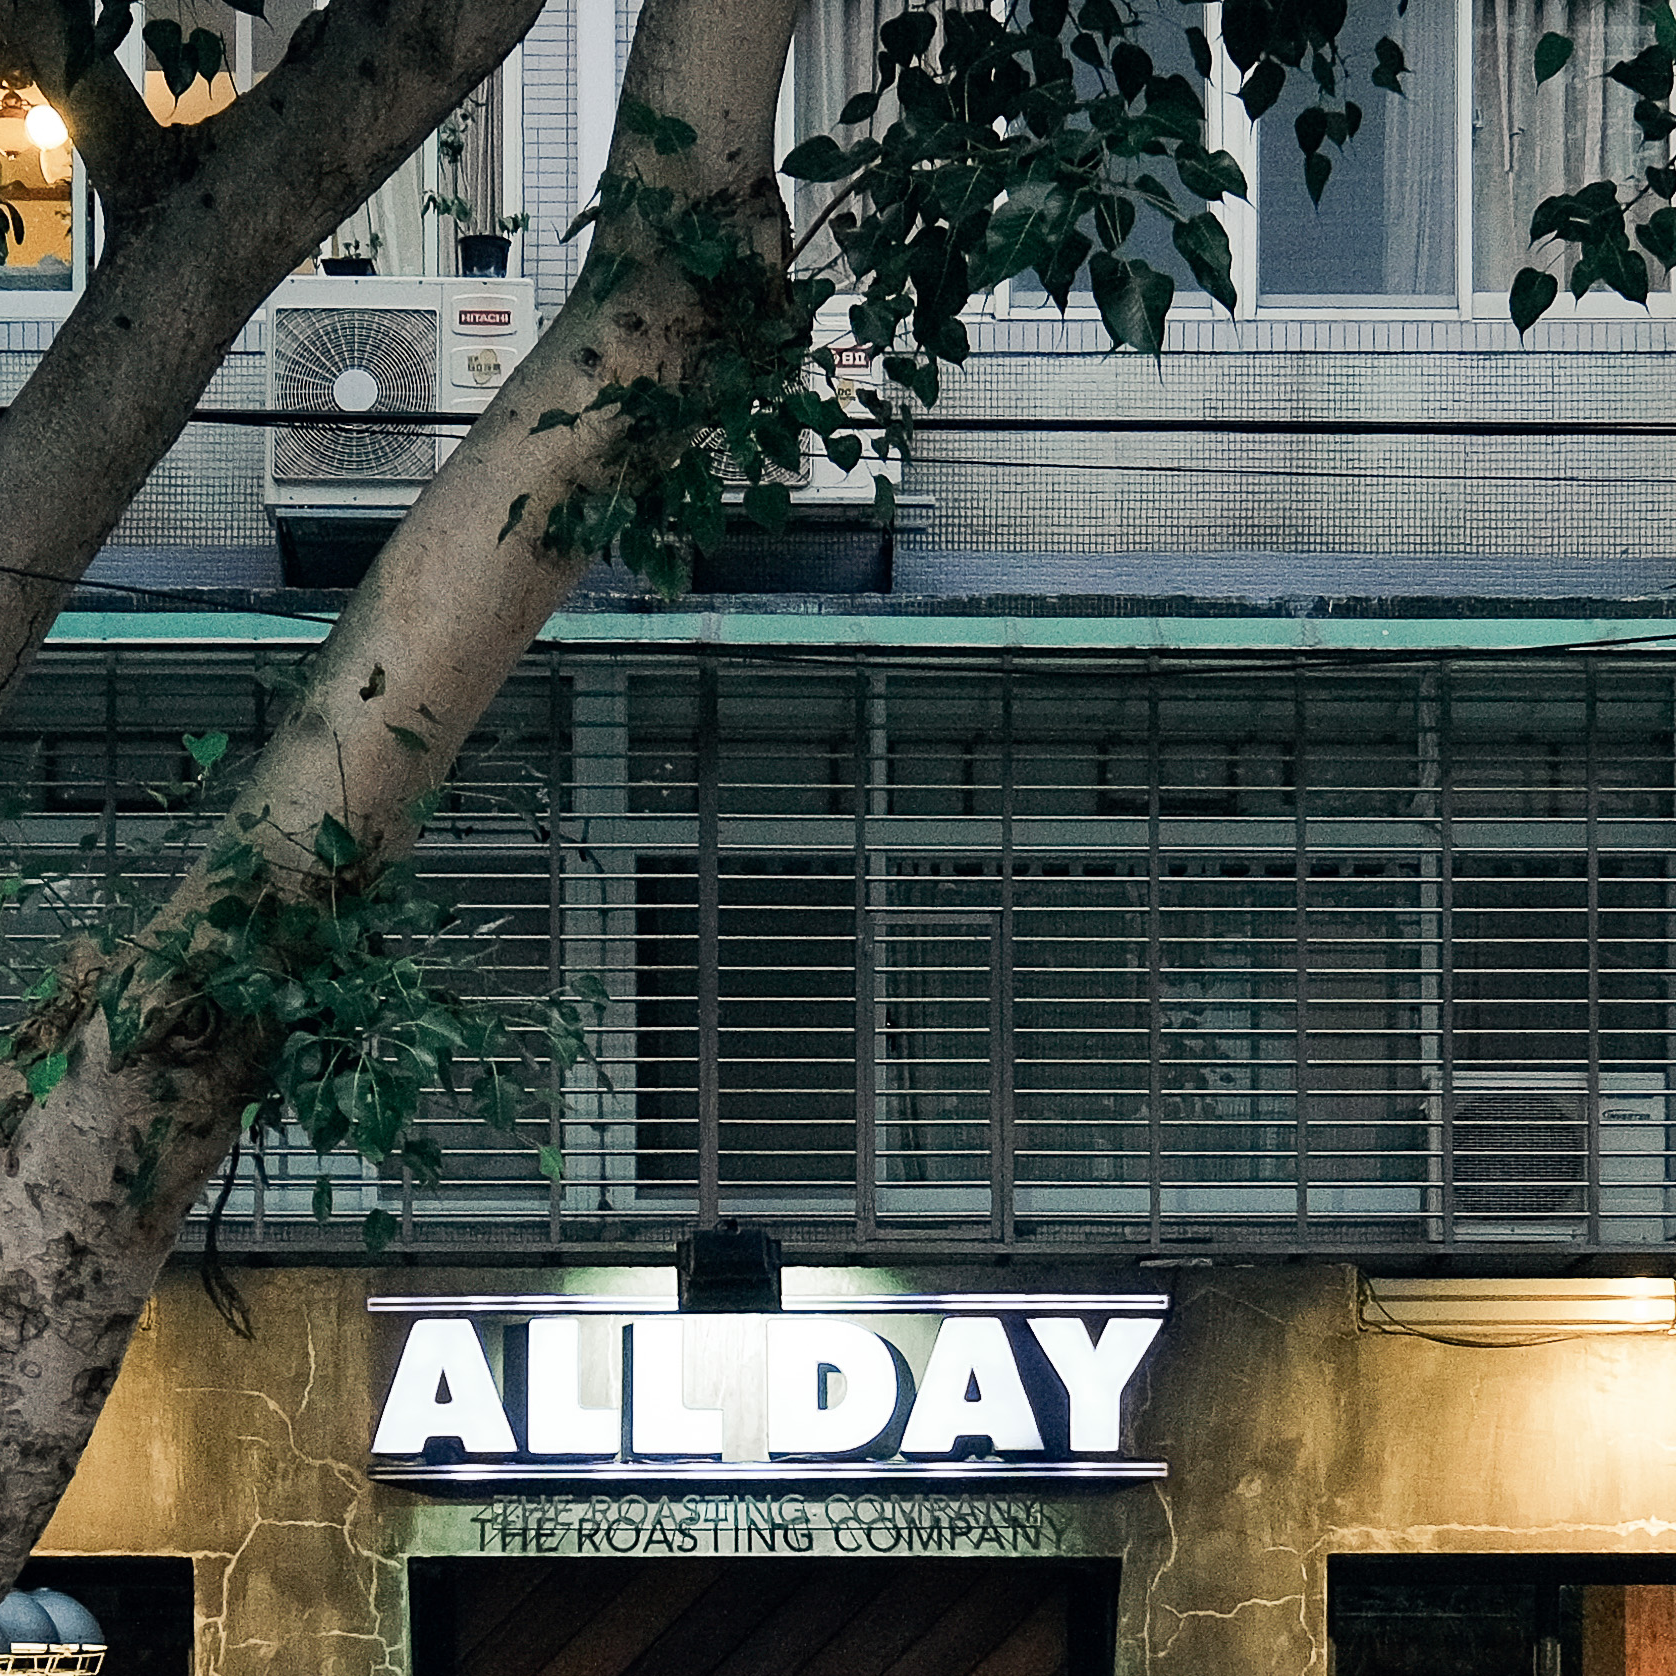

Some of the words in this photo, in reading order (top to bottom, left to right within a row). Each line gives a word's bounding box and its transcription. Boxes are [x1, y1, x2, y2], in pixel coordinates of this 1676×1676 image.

[461, 314, 509, 323] HITACHI
[369, 1317, 724, 1455] ALL
[767, 1317, 1164, 1454] DAY
[586, 1494, 812, 1541] ROASTING
[824, 1493, 1048, 1541] COMPANY
